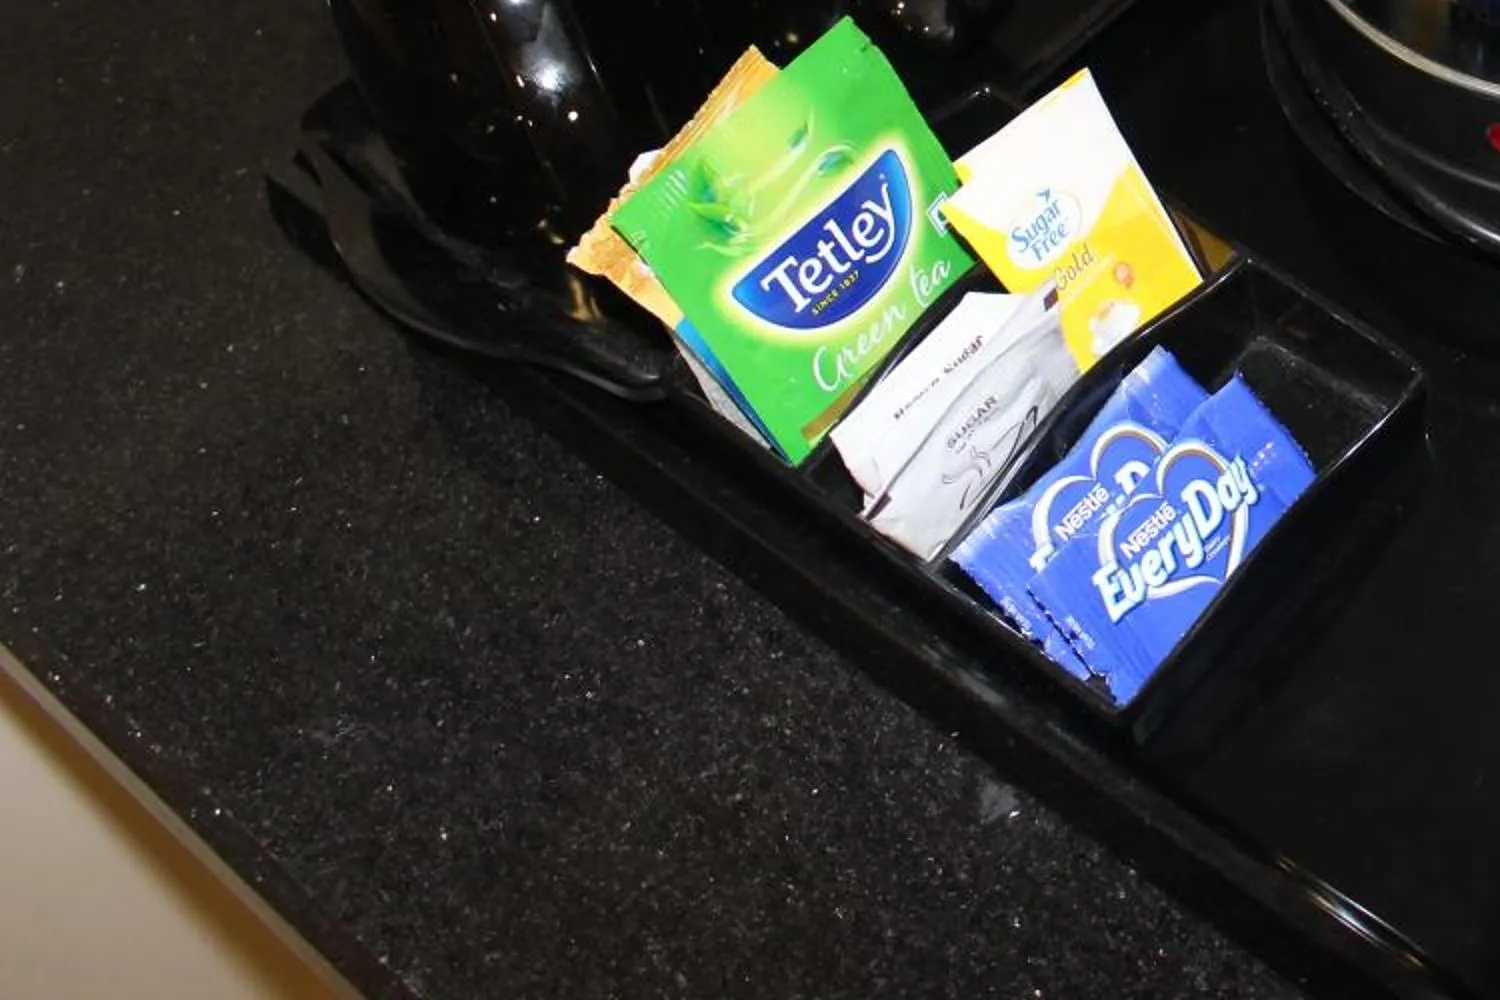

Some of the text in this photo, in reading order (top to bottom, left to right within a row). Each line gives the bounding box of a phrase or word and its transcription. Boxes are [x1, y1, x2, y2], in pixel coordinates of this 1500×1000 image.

[760, 181, 899, 314] Tetley
[1010, 199, 1062, 254] Sugar
[1027, 224, 1070, 262] Free
[1053, 242, 1096, 292] Gold
[811, 291, 840, 317] SINCE
[812, 256, 952, 393] Green tea
[945, 395, 999, 450] SUGAR
[1091, 454, 1261, 624] EveryDay
